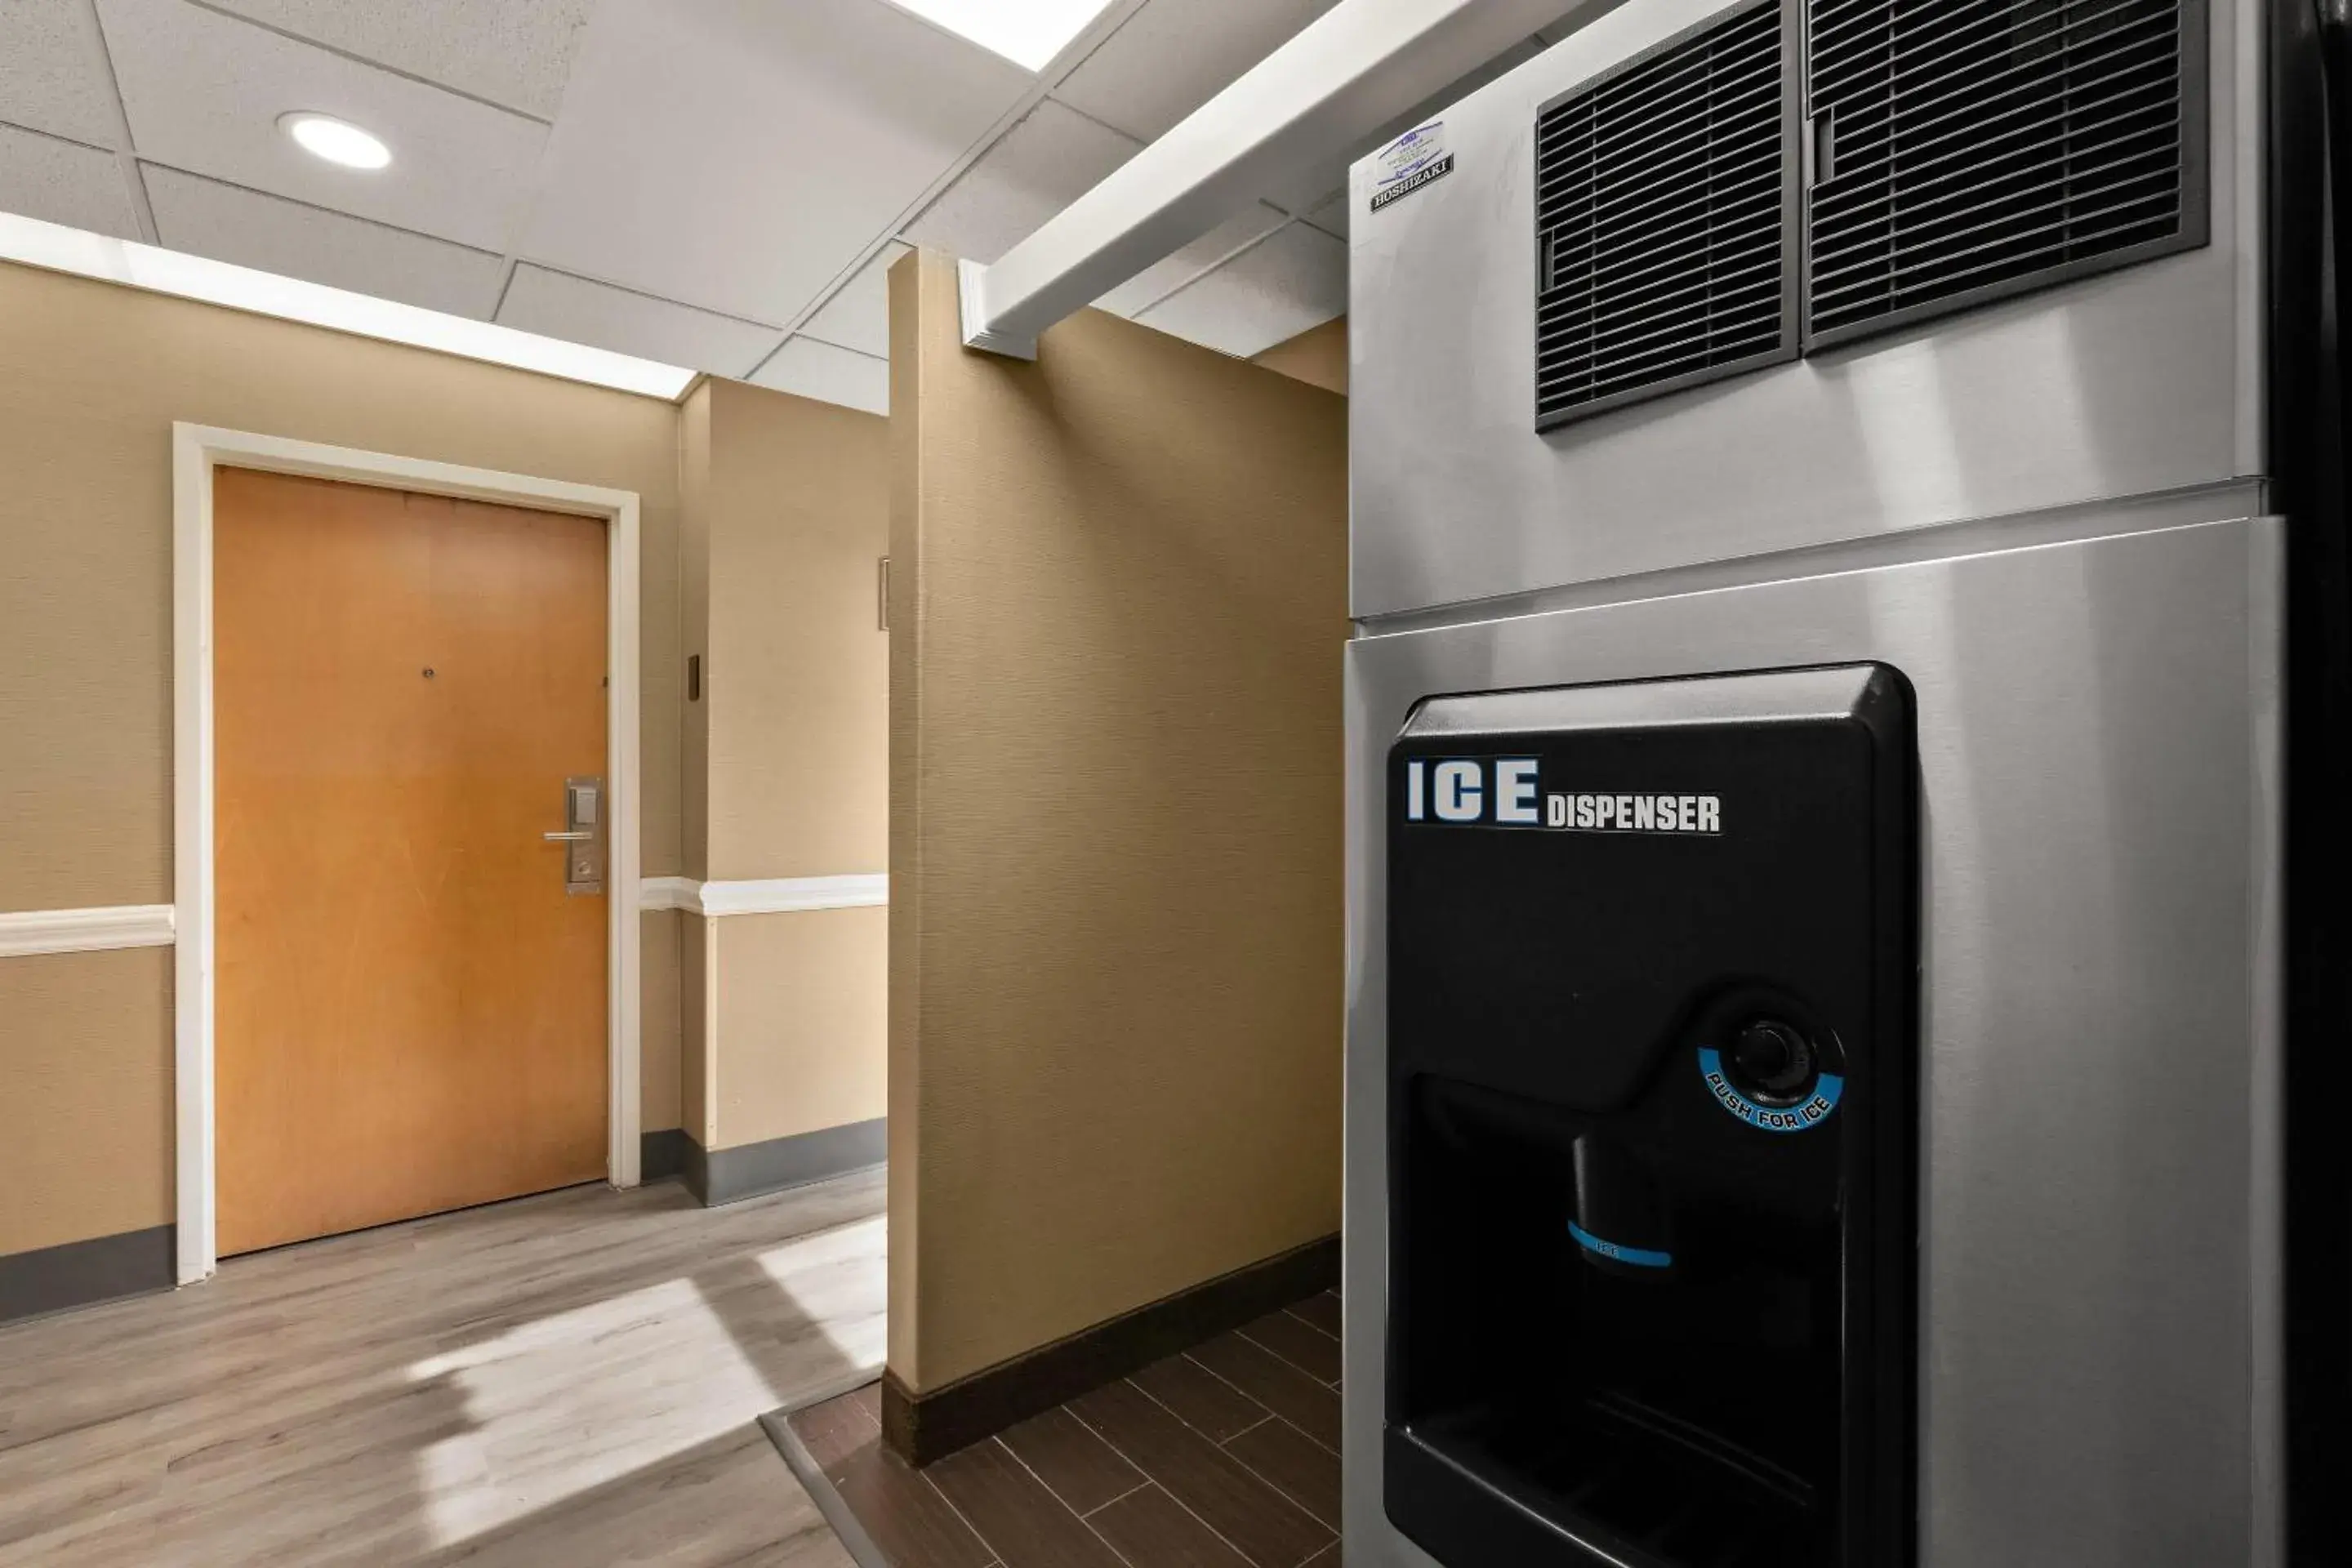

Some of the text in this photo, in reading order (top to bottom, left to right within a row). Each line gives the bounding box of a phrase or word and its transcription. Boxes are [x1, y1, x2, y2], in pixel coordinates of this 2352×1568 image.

[1374, 160, 1447, 207] HOSHIZAKI
[1408, 759, 1720, 831] ICE DISPENSER
[1706, 1073, 1831, 1129] PUSH FOR ICE
